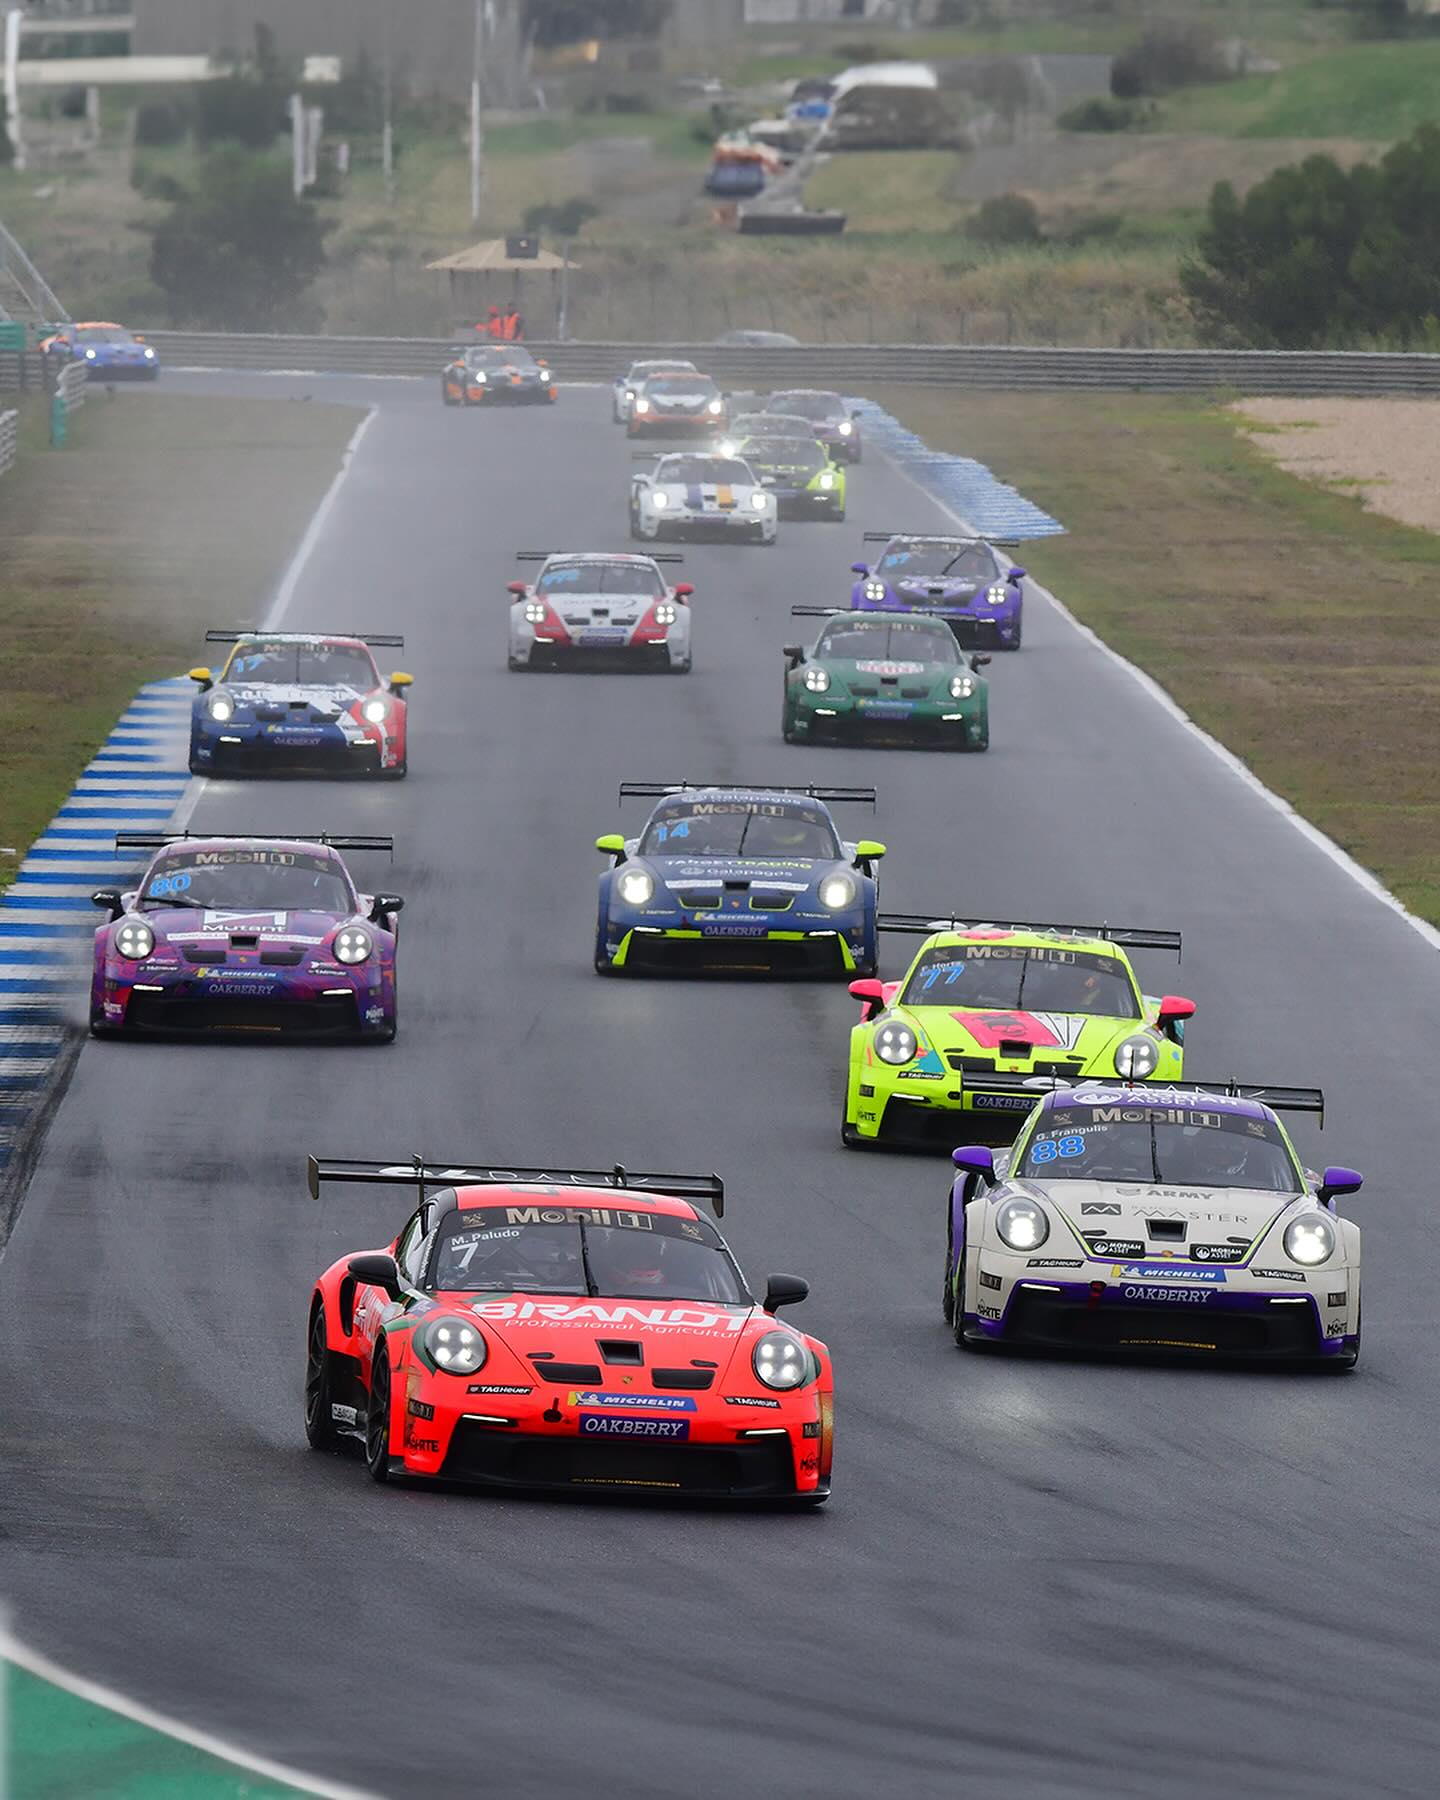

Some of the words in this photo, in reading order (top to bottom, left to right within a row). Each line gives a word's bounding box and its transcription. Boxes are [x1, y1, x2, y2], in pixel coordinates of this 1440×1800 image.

[693, 804, 758, 815] Mobil
[656, 821, 690, 843] 14
[195, 852, 267, 864] Mobil
[149, 873, 192, 898] 80
[202, 924, 287, 933] Mutant
[704, 926, 764, 936] OAKBERRY
[966, 947, 1044, 961] Mobil
[221, 970, 277, 978] MICHELIN
[920, 963, 965, 990] 77
[208, 984, 275, 995] OAKBERRY
[1092, 1107, 1184, 1123] Mobil
[1036, 1132, 1051, 1141] G.
[1030, 1135, 1086, 1165] 88
[1147, 1189, 1217, 1200] ARMY
[505, 1207, 611, 1225] Mobil
[451, 1235, 469, 1246] M.
[470, 1228, 520, 1243] Paludo
[451, 1242, 479, 1268] 7
[1143, 1269, 1216, 1279] MICHELIN
[1124, 1286, 1212, 1303] OAKBERRY
[472, 1301, 749, 1331] BRANDT
[505, 1319, 634, 1331] Professional
[640, 1324, 752, 1339] Agriculture
[603, 1396, 685, 1407] MICHELIN
[585, 1418, 683, 1436] OAKBERRY
